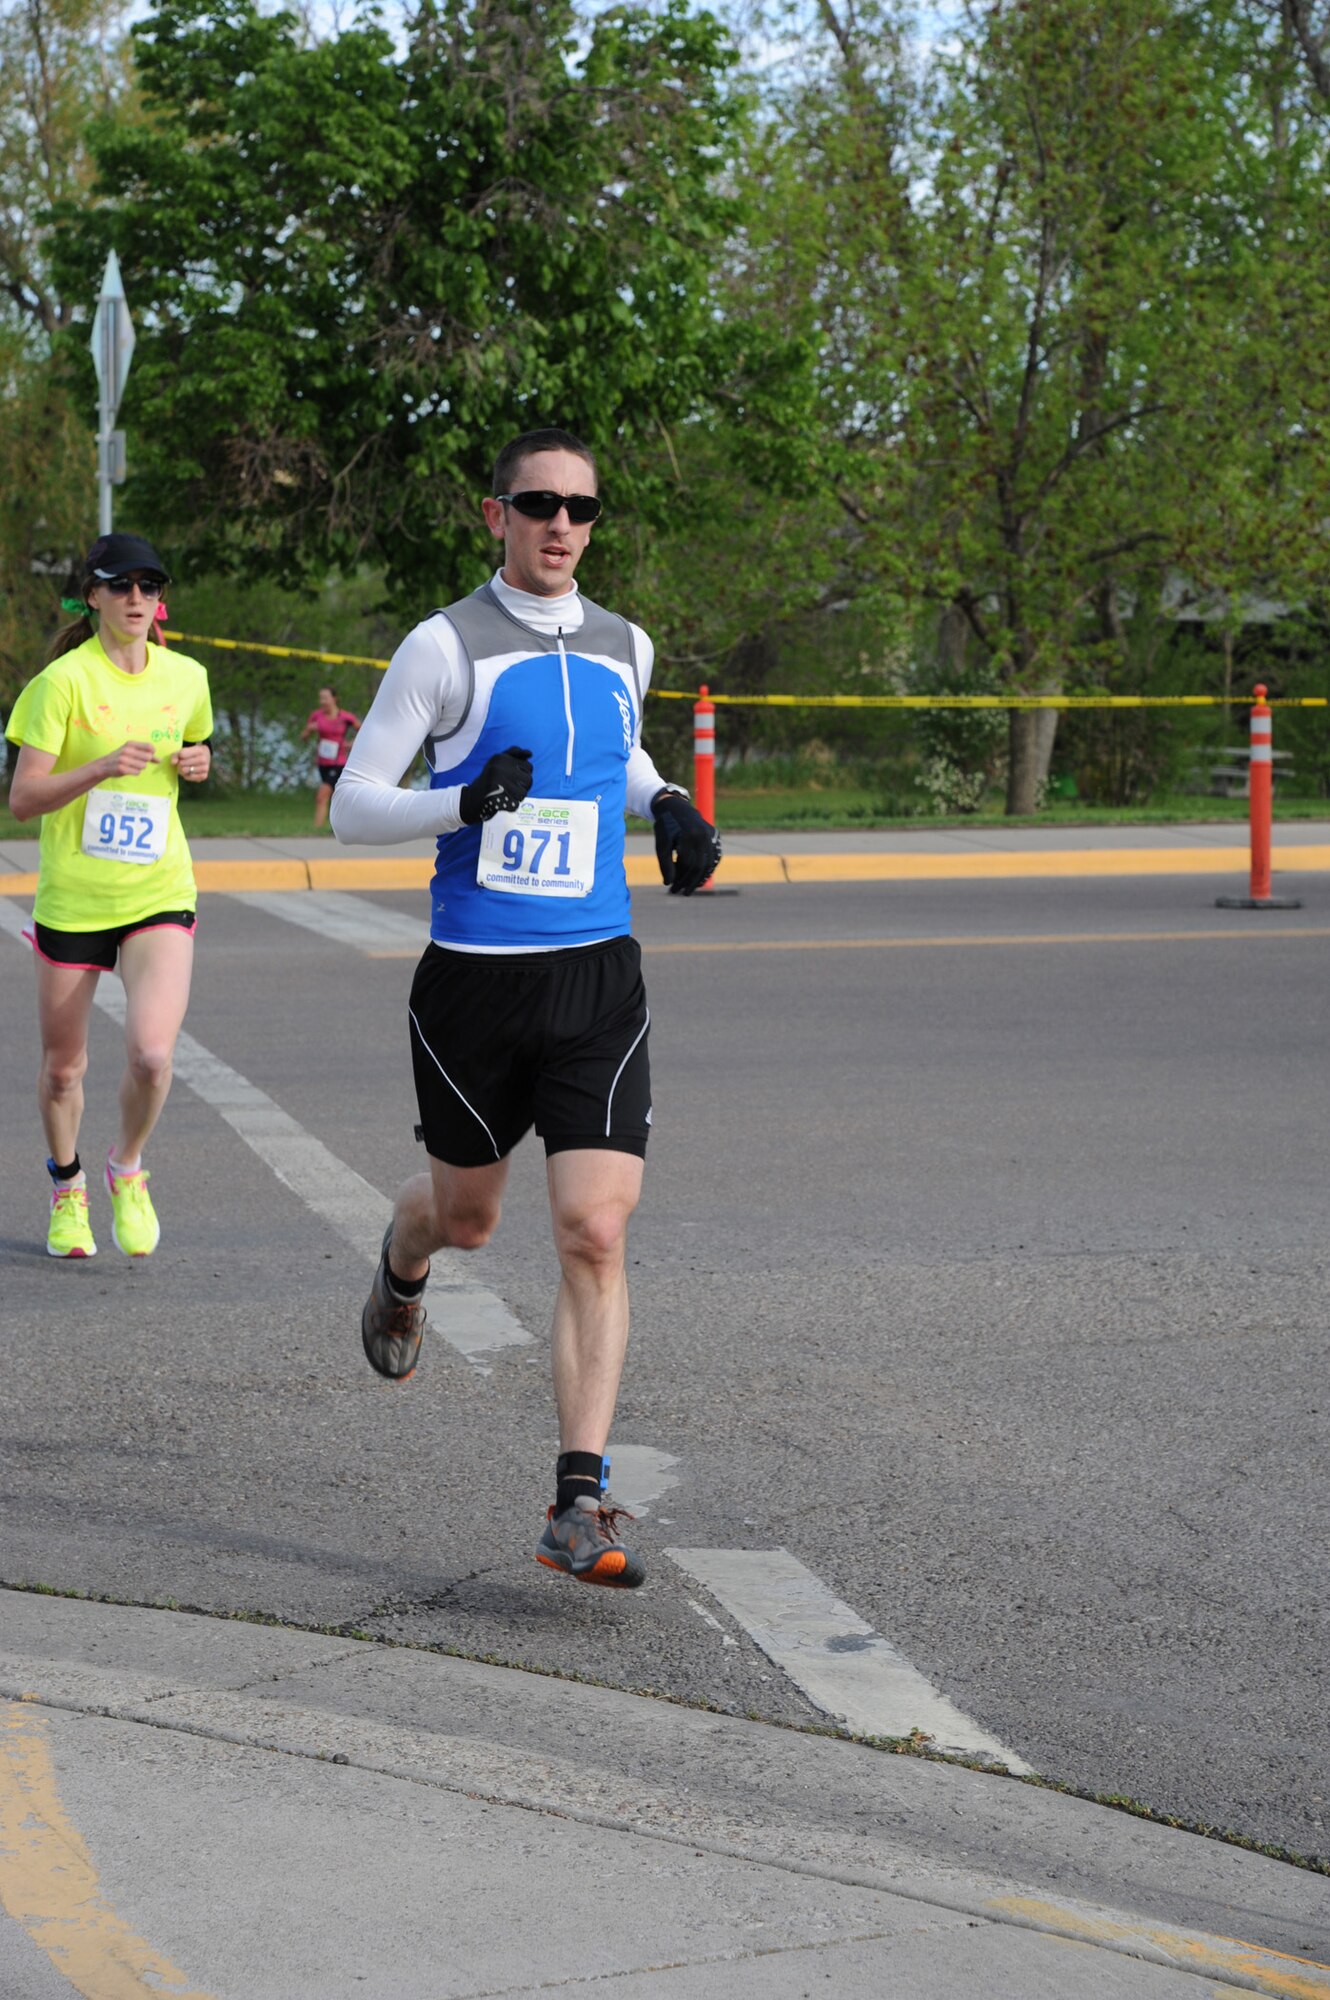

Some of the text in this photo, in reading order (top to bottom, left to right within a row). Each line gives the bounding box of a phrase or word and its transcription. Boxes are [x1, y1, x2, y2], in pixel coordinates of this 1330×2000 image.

[537, 809, 570, 818] race
[99, 813, 153, 849] 952
[502, 829, 571, 875] 971
[486, 873, 585, 891] committed to community
